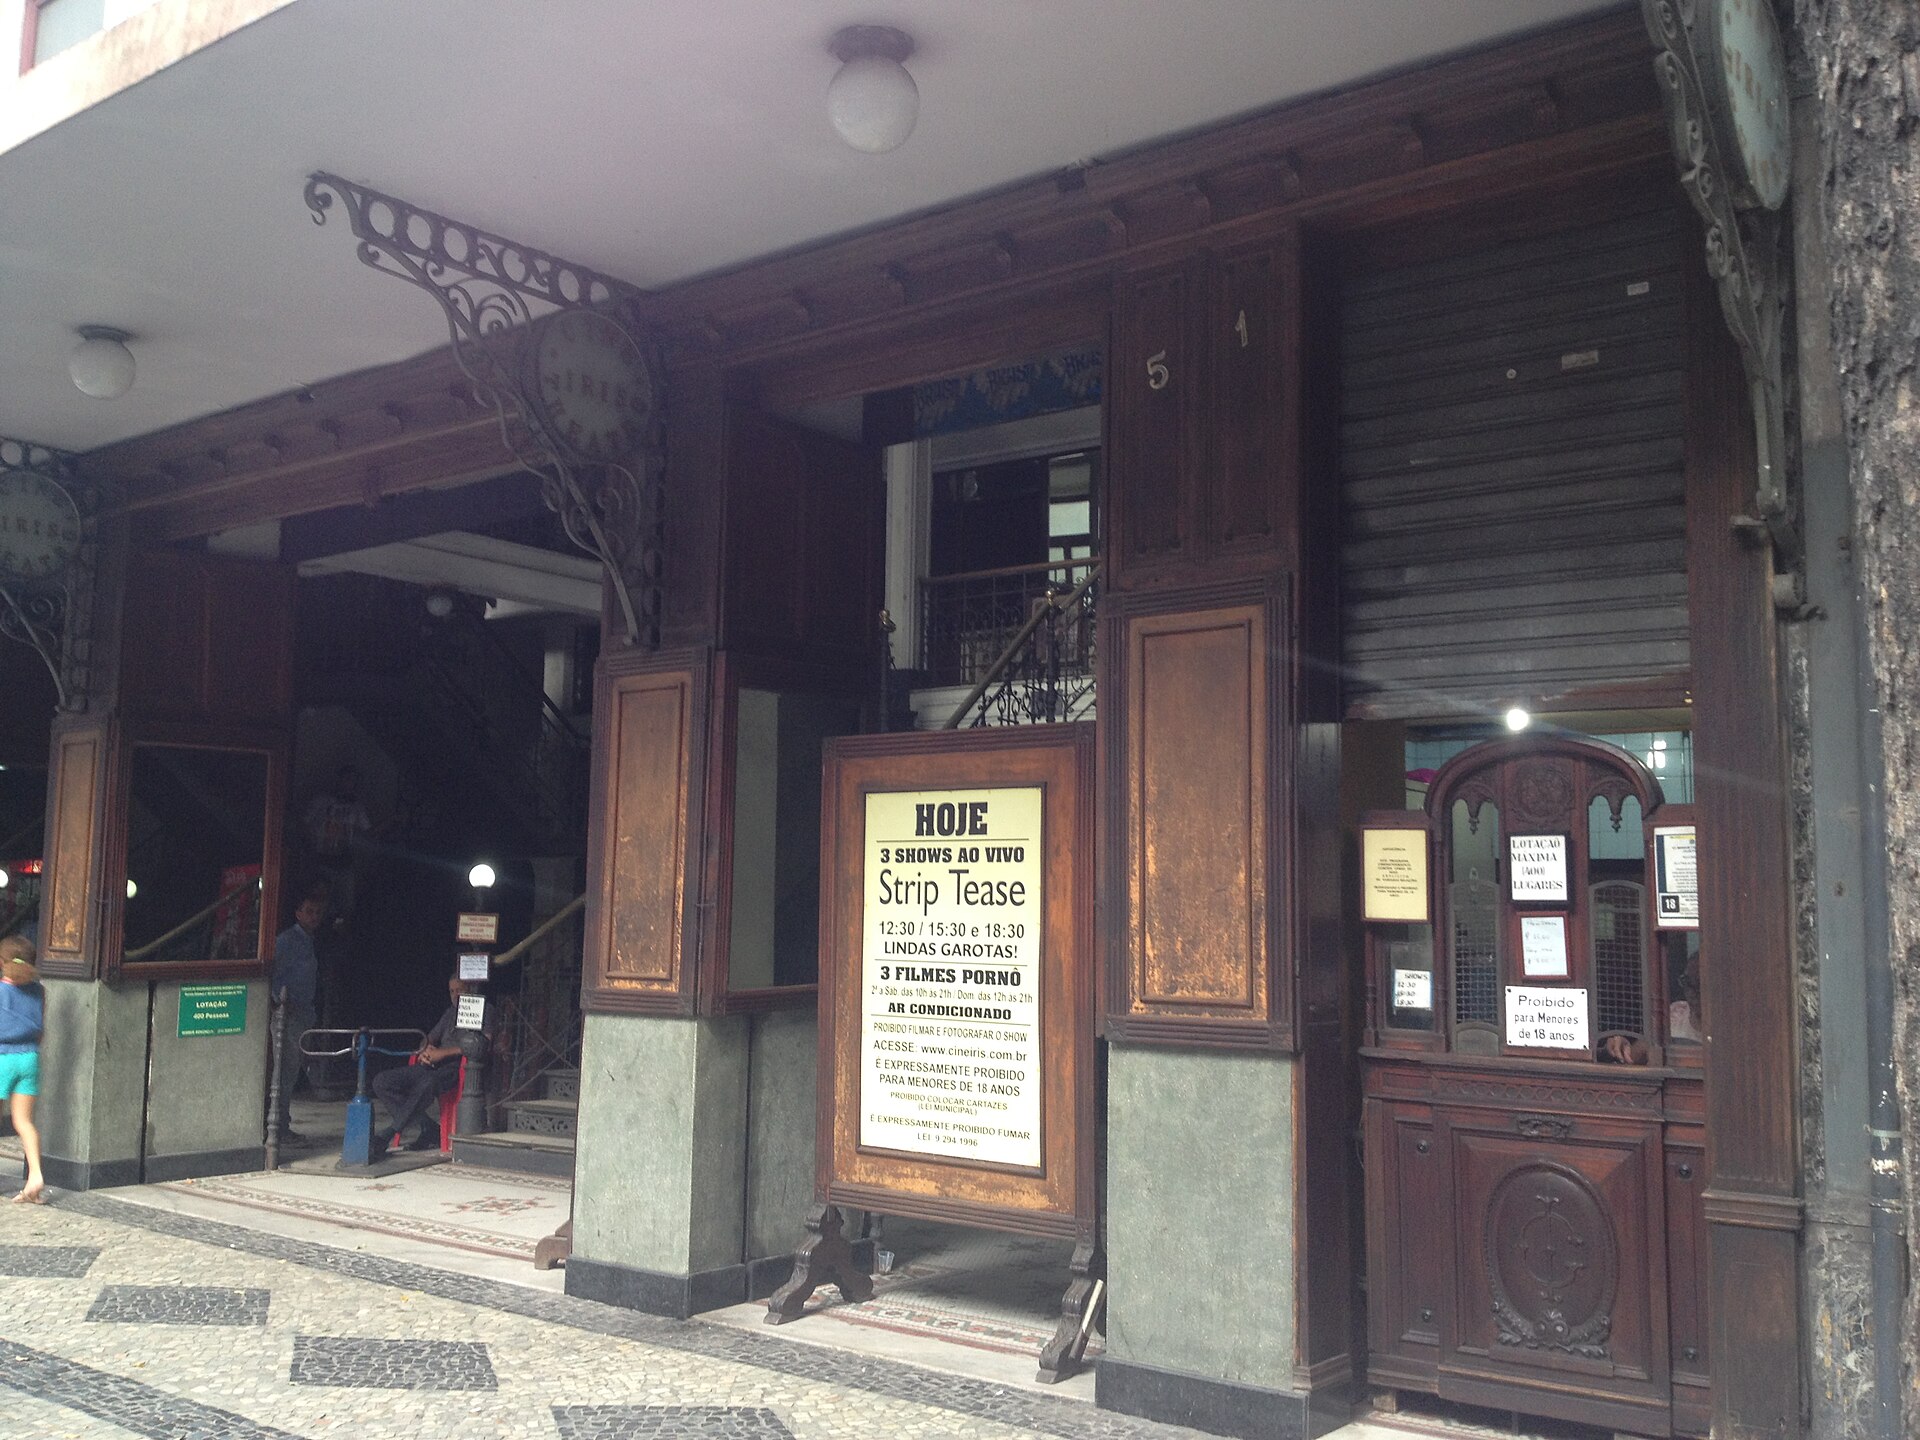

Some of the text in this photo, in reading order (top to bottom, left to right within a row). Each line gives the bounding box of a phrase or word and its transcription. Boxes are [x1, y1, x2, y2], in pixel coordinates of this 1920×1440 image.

[1146, 310, 1248, 390] 5 1
[915, 802, 988, 836] HOJE
[881, 847, 1024, 862] 3 SHOWS AO VIVO
[1512, 851, 1557, 862] MÁXIMA
[879, 869, 1025, 916] Strip Tease
[1513, 880, 1562, 890] LUGARES
[1665, 898, 1676, 910] 18
[879, 921, 1024, 938] 12:30 / 15:30 e 18:30
[884, 941, 1018, 958] LINDAS GAROTAS!
[880, 966, 1021, 986] 3 FILMES PORNÔ
[901, 987, 913, 996] das
[916, 988, 927, 997] 10h
[939, 989, 951, 998] 21h
[978, 991, 990, 1001] das
[994, 992, 1006, 1002] 12h
[1019, 992, 1032, 1003] 21h
[1519, 995, 1574, 1007] Proibido
[196, 1000, 228, 1009] LOTAÇÃO
[888, 1002, 1011, 1020] AR CONDICIONADO
[1514, 1012, 1579, 1024] para Menores
[874, 1022, 1027, 1042] PROIBIDO FILMAR E FOTOGRAFAR O SHOW
[1519, 1028, 1575, 1041] de 18 anos
[873, 1040, 1027, 1061] ACESSE: www.cineiris.com.br
[876, 1056, 1025, 1081] É EXPRESSAMENTE PROIBIDO
[880, 1074, 1020, 1096] PARA MENORES DE 18 ANOS
[890, 1092, 1007, 1110] PROIBIDO COLOCAR CARTAZES
[934, 1104, 977, 1116] MUNICIPAL)
[878, 1115, 950, 1130] EXPRESSAMENTE
[953, 1124, 995, 1135] PROIBIDO
[998, 1129, 1030, 1140] FUMAR
